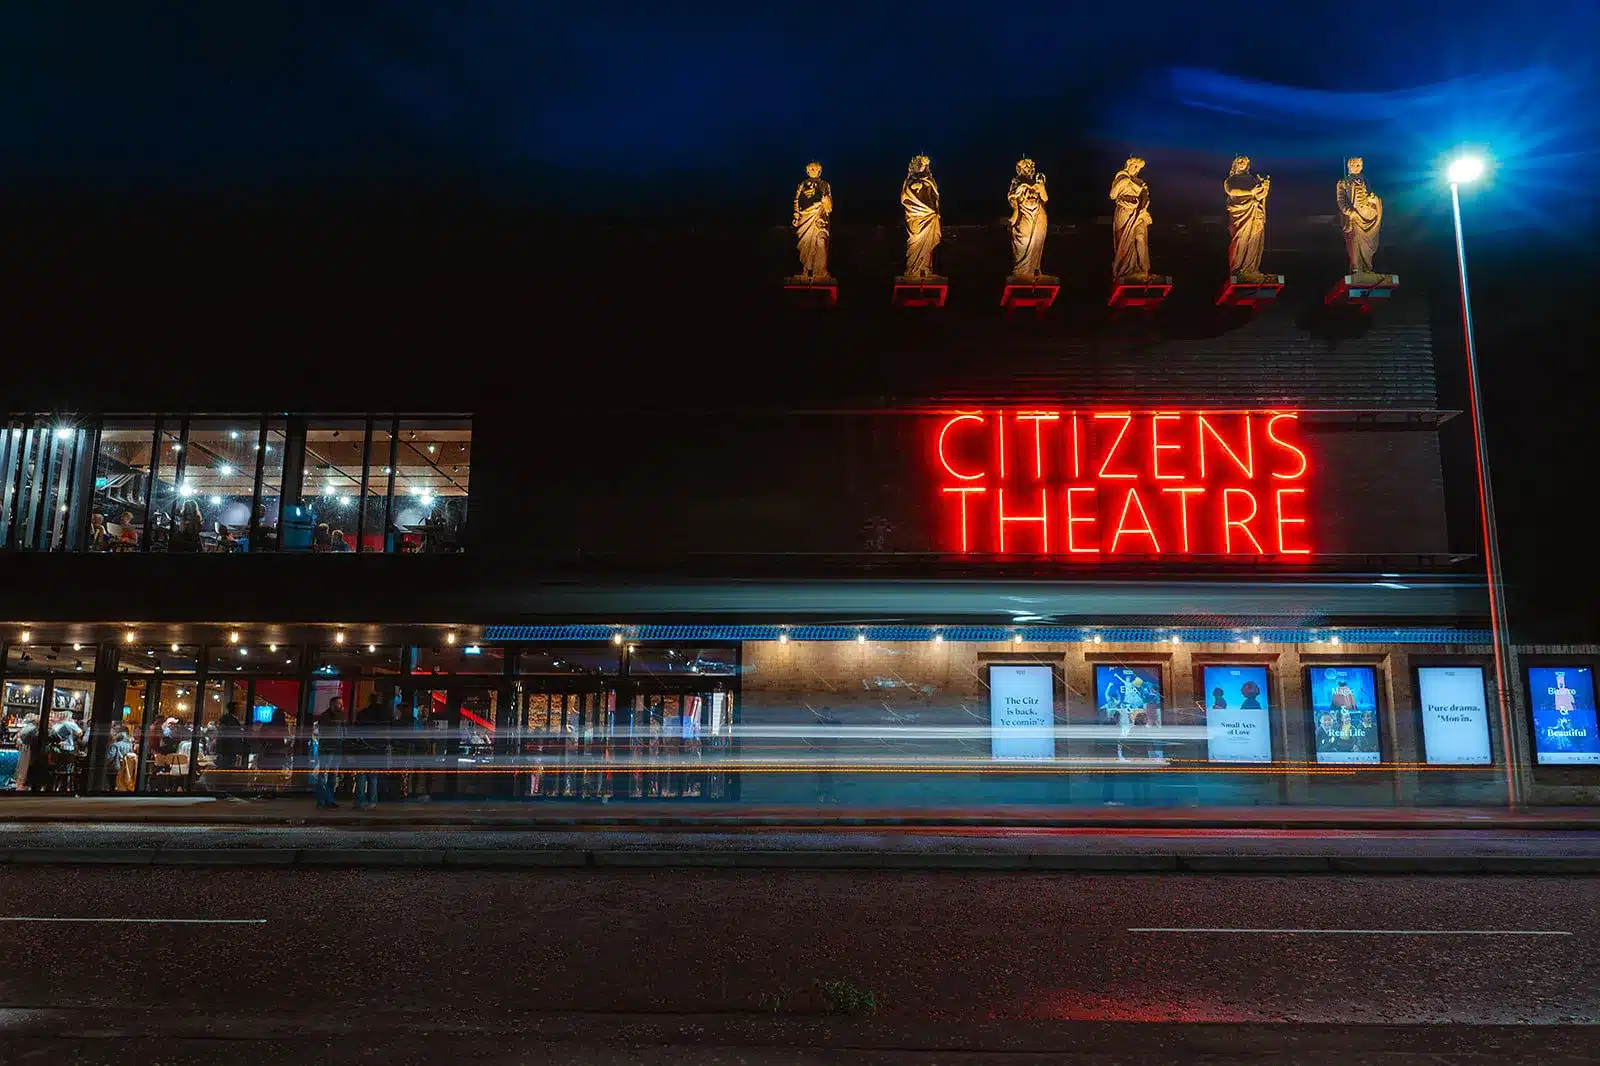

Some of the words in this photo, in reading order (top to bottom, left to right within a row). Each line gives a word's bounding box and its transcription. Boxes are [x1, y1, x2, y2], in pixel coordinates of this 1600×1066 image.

[938, 412, 1308, 480] CITIZENS
[942, 486, 1311, 555] THEATRE
[1004, 696, 1021, 705] The
[1022, 696, 1040, 705] Citz
[1006, 707, 1014, 715] is
[1014, 707, 1038, 715] back.
[1340, 705, 1350, 716] &
[1427, 704, 1449, 712] Pure
[1449, 704, 1481, 712] drama.
[1560, 705, 1569, 716] &
[1000, 718, 1011, 726] Ye
[1328, 728, 1348, 737] Real
[1349, 728, 1366, 737] Life
[1547, 728, 1587, 737] Beautiful
